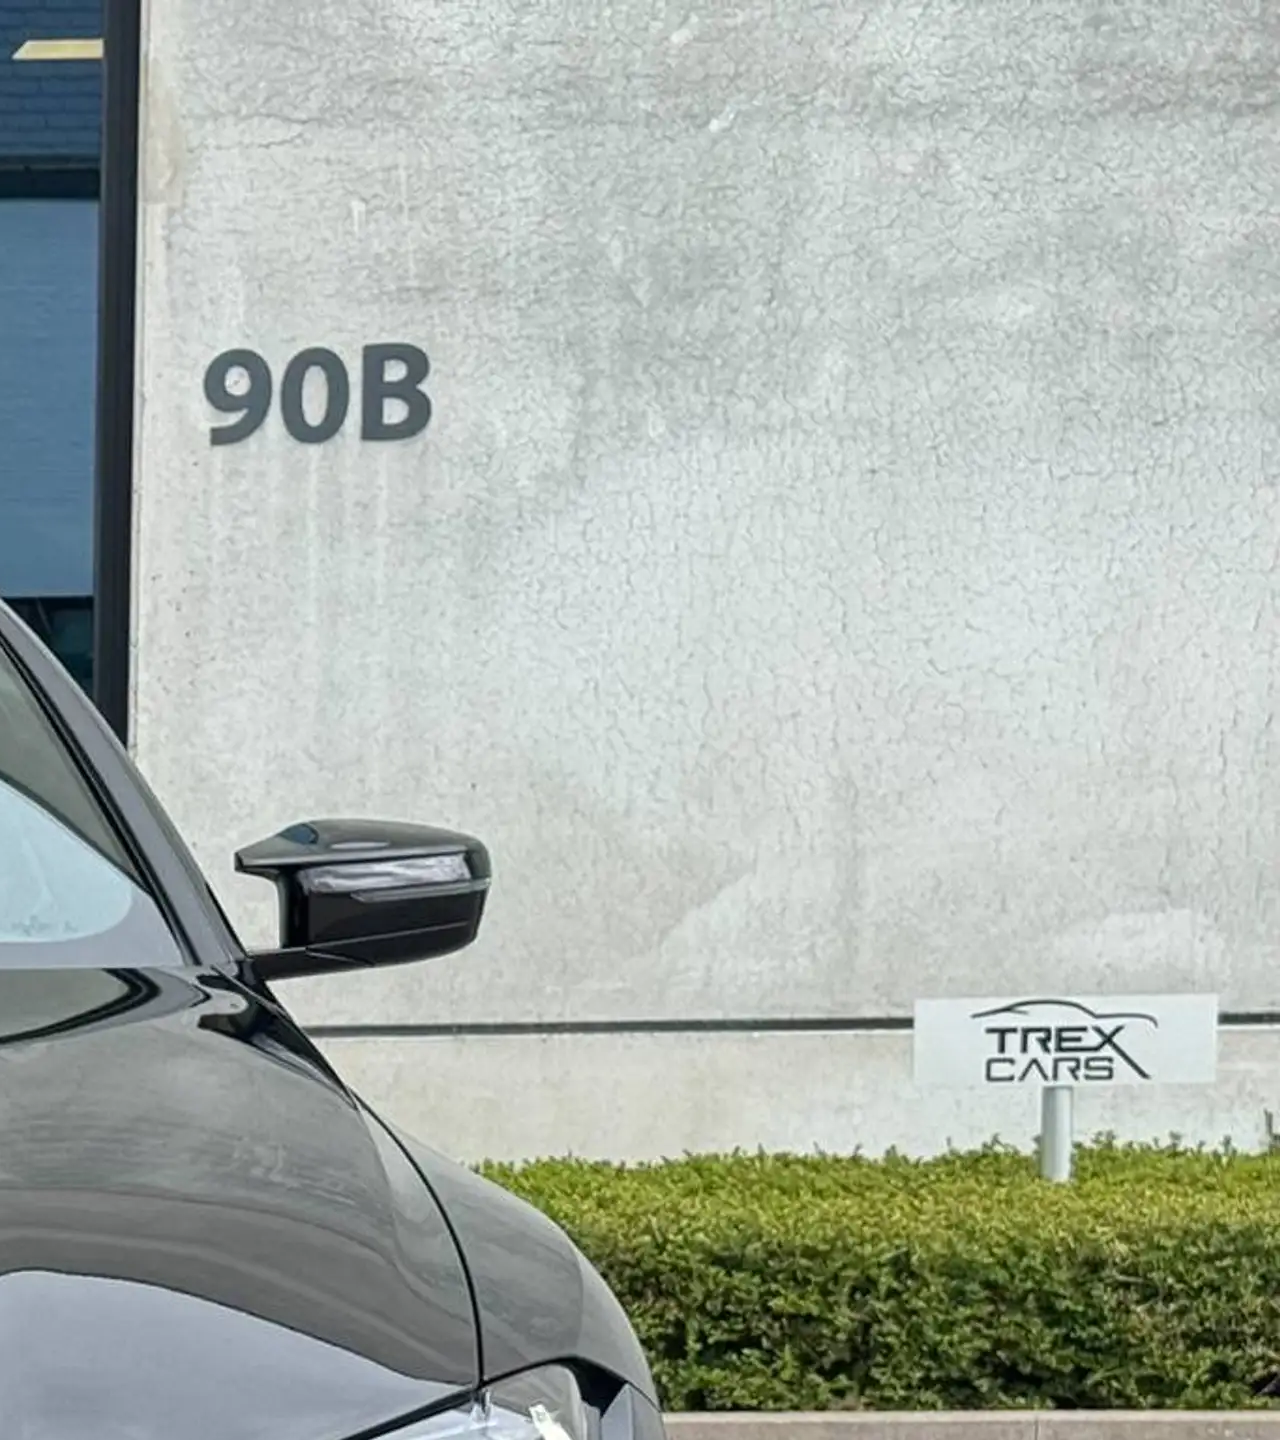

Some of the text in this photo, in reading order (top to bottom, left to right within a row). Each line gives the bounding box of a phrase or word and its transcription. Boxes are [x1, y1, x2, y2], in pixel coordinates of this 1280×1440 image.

[203, 342, 433, 446] 90B
[985, 1025, 1152, 1079] TREX
[985, 1056, 1114, 1082] CARS
